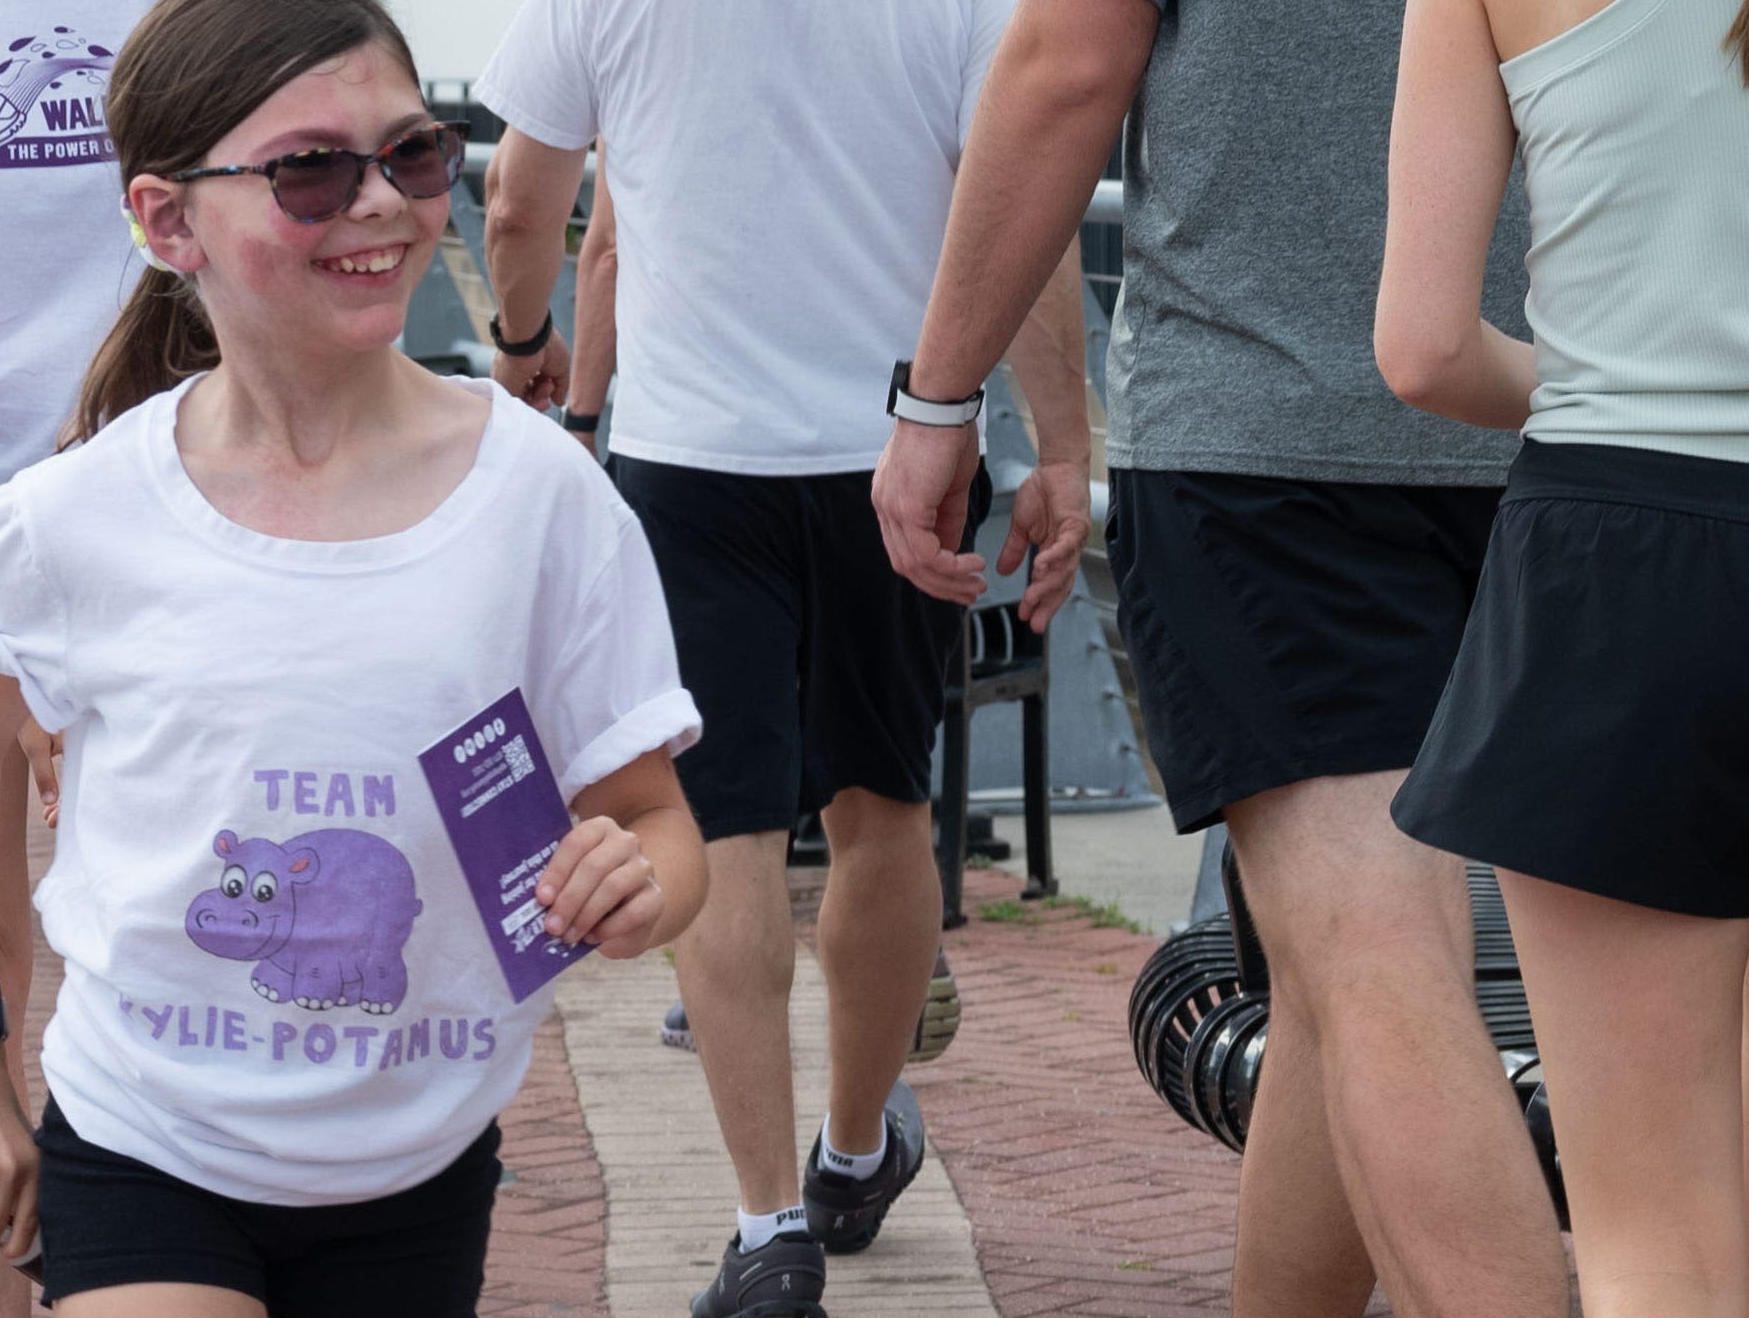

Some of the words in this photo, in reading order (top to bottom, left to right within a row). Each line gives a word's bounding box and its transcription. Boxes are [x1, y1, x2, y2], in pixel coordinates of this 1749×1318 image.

[7, 143, 40, 161] THE
[44, 140, 100, 159] POWER
[253, 768, 398, 818] TEAM
